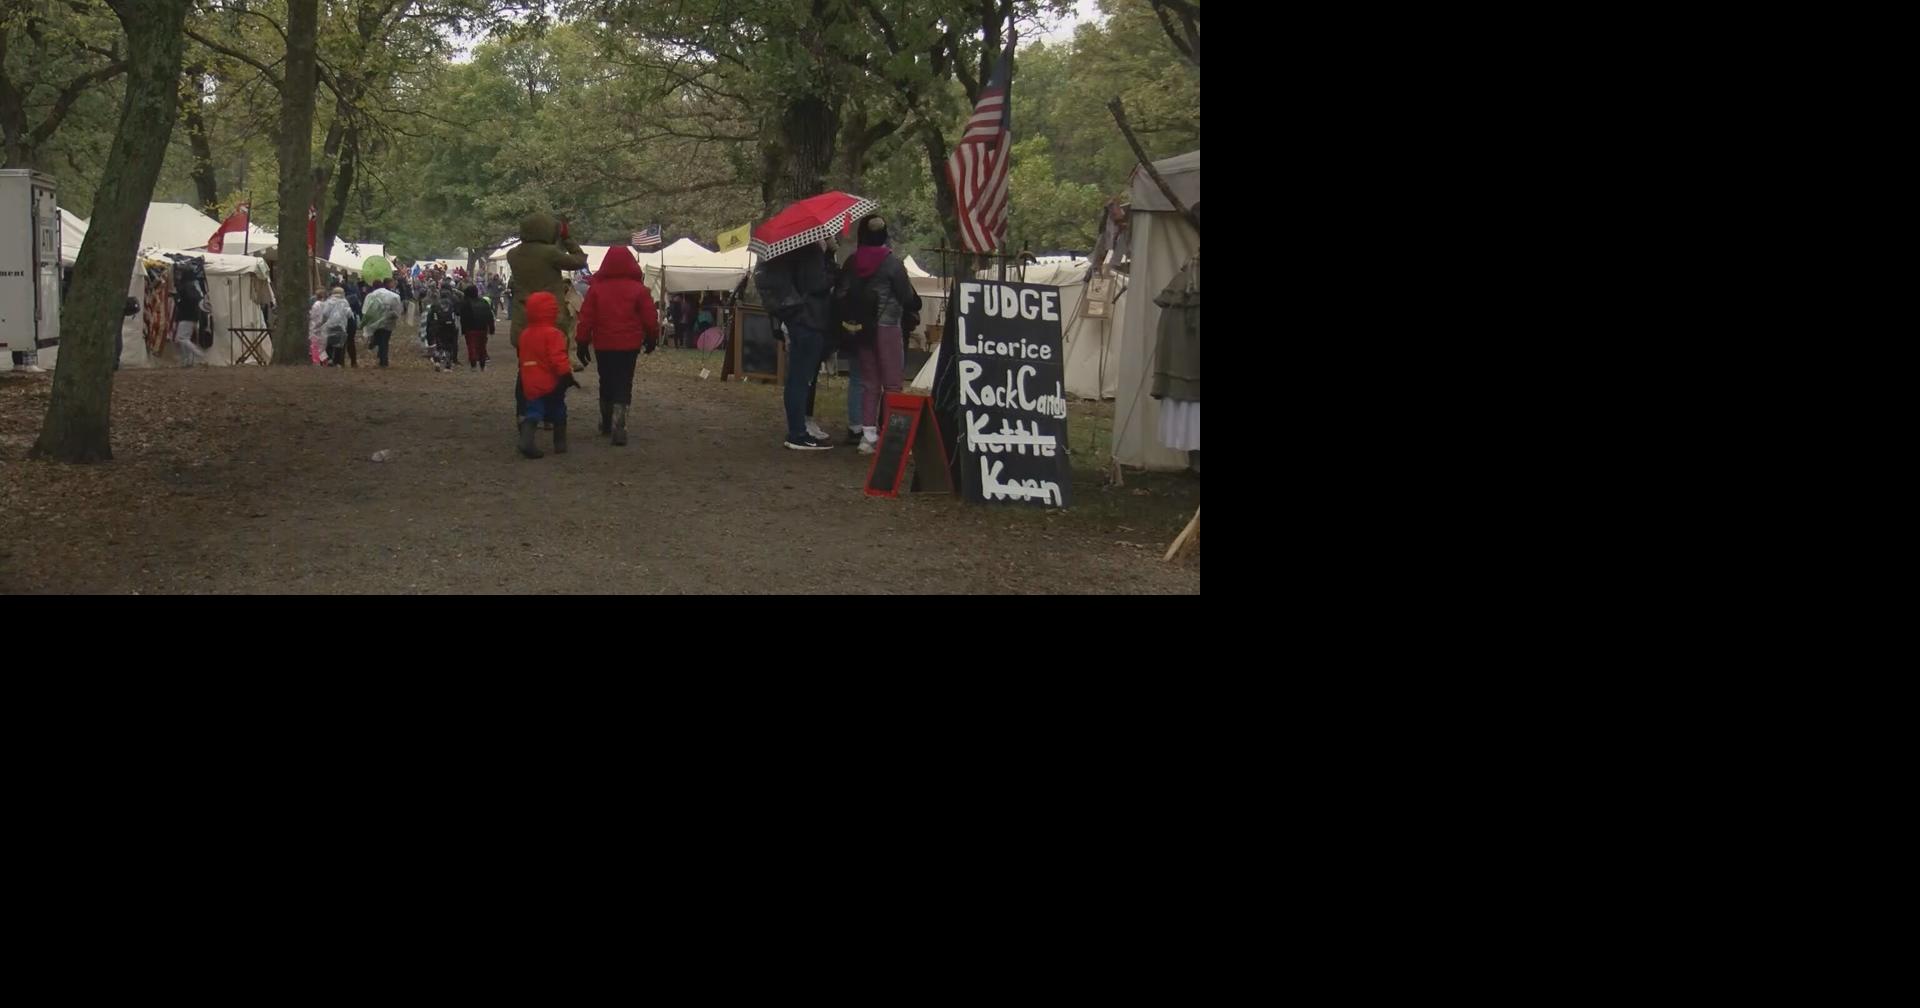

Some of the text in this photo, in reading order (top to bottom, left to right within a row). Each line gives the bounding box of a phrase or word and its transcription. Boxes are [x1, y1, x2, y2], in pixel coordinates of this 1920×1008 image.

[960, 282, 1059, 321] FUDGE
[958, 316, 1052, 360] Licorice
[959, 359, 1067, 419] Rock Candy
[965, 410, 1057, 456] Kettle
